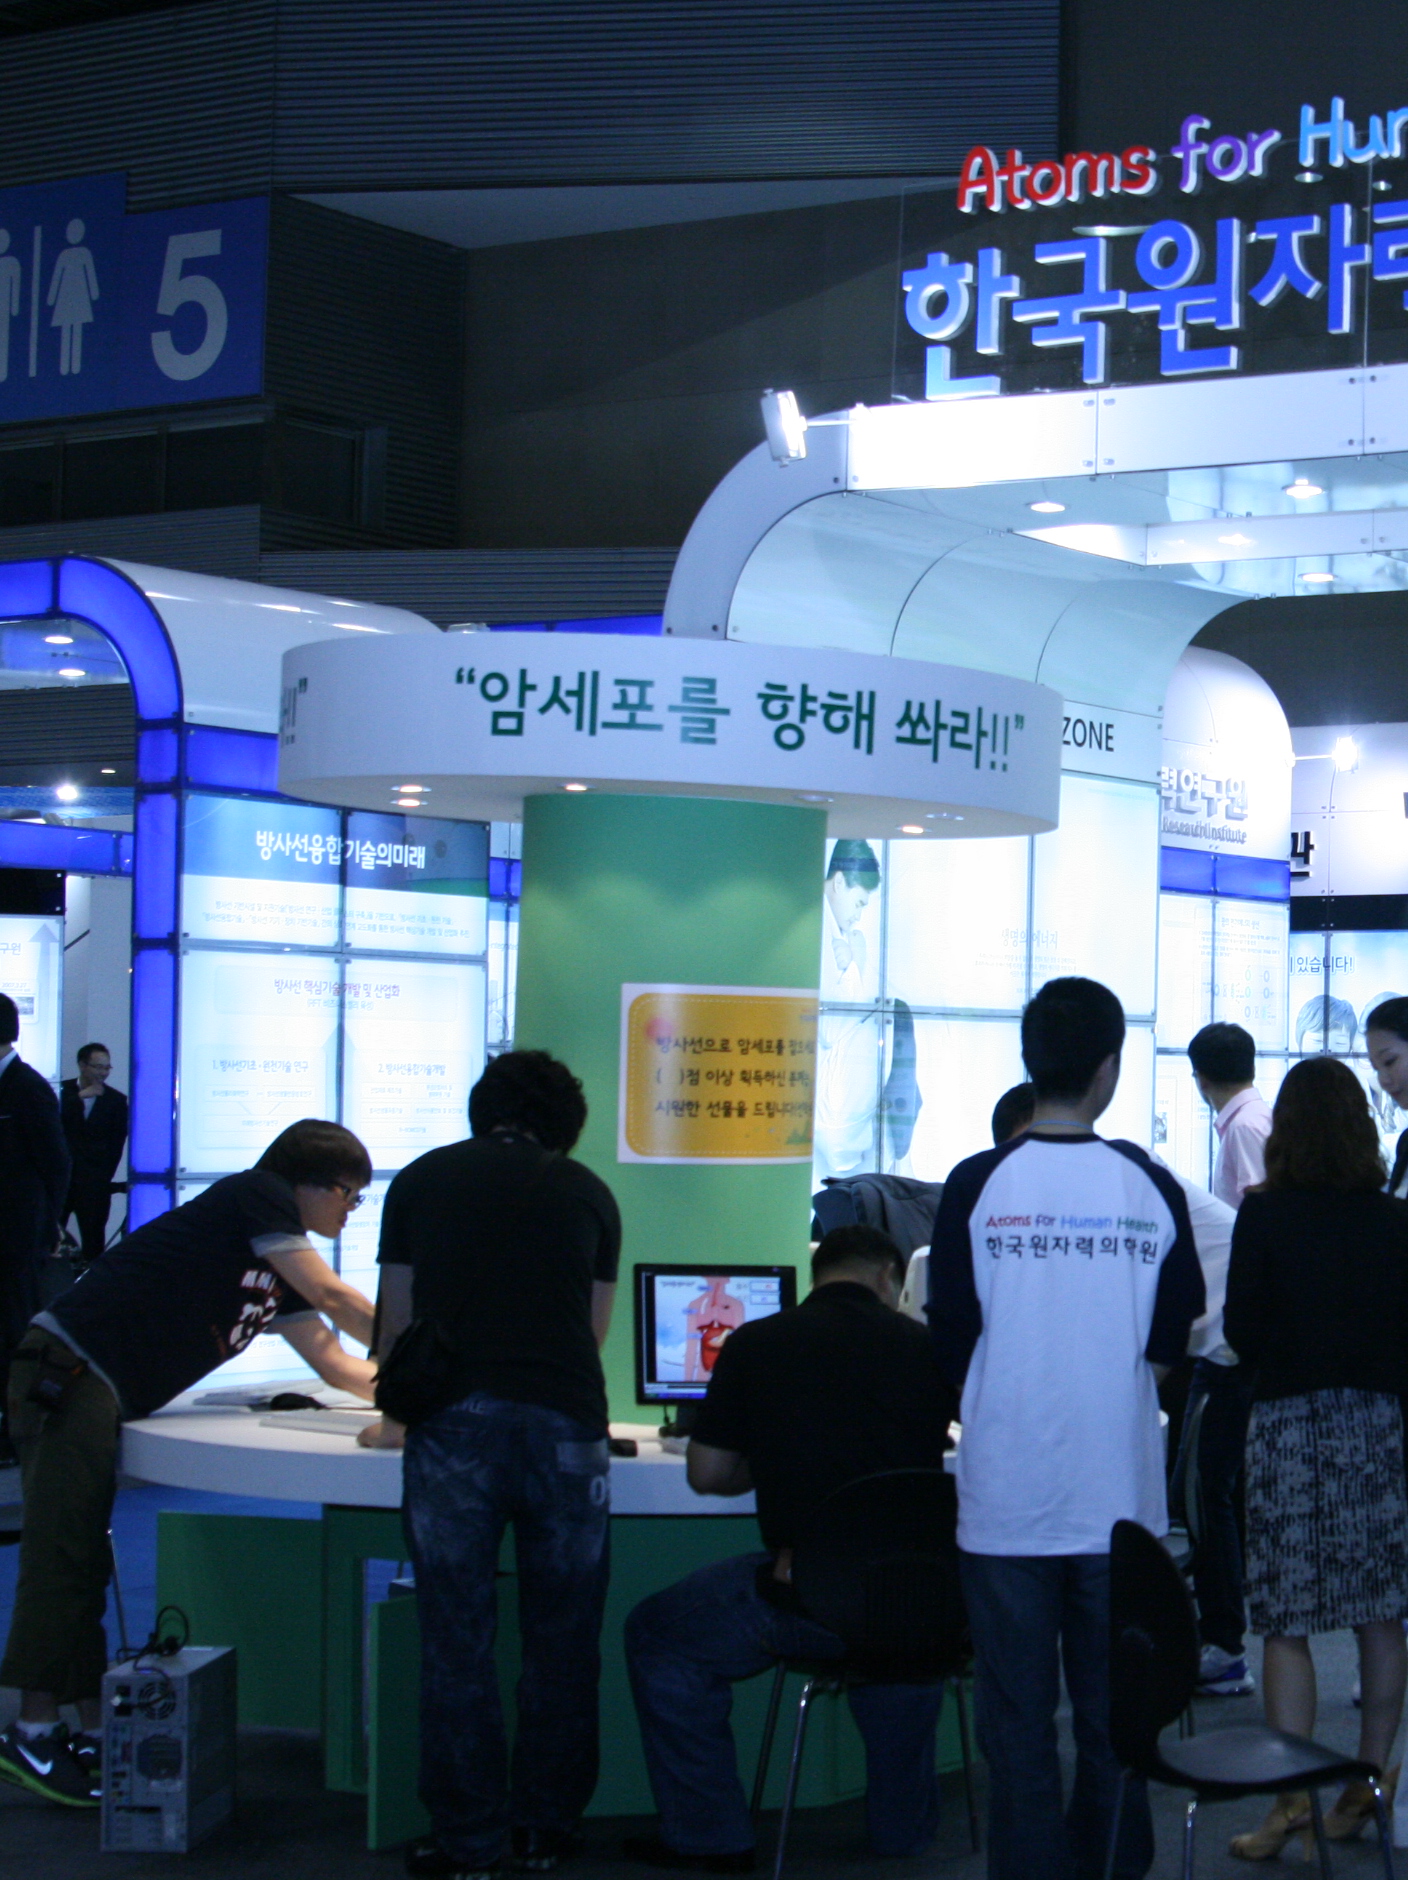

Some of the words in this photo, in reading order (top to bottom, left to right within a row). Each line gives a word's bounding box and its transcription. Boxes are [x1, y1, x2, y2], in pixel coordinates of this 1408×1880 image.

[957, 144, 1157, 213] Atoms
[1179, 114, 1281, 195] for
[150, 228, 229, 382] 5
[757, 681, 876, 756] 향해
[1062, 716, 1115, 753] ZONE
[1296, 956, 1354, 973] 있습니다!
[274, 979, 302, 994] 방사선
[303, 980, 341, 996] 핵심기술
[363, 983, 372, 998] 및
[374, 984, 401, 999] 산업화
[656, 1037, 732, 1054] 방사선으로
[737, 1038, 785, 1056] 암세포를
[705, 1069, 734, 1087] 이상
[655, 1100, 700, 1117] 시원한
[706, 1100, 747, 1118] 선물을
[986, 1215, 1032, 1228] Atoms
[1035, 1214, 1056, 1228] for
[1061, 1215, 1113, 1230] Human
[1116, 1216, 1159, 1234] Health
[986, 1234, 1159, 1265] 한국원자력의학원
